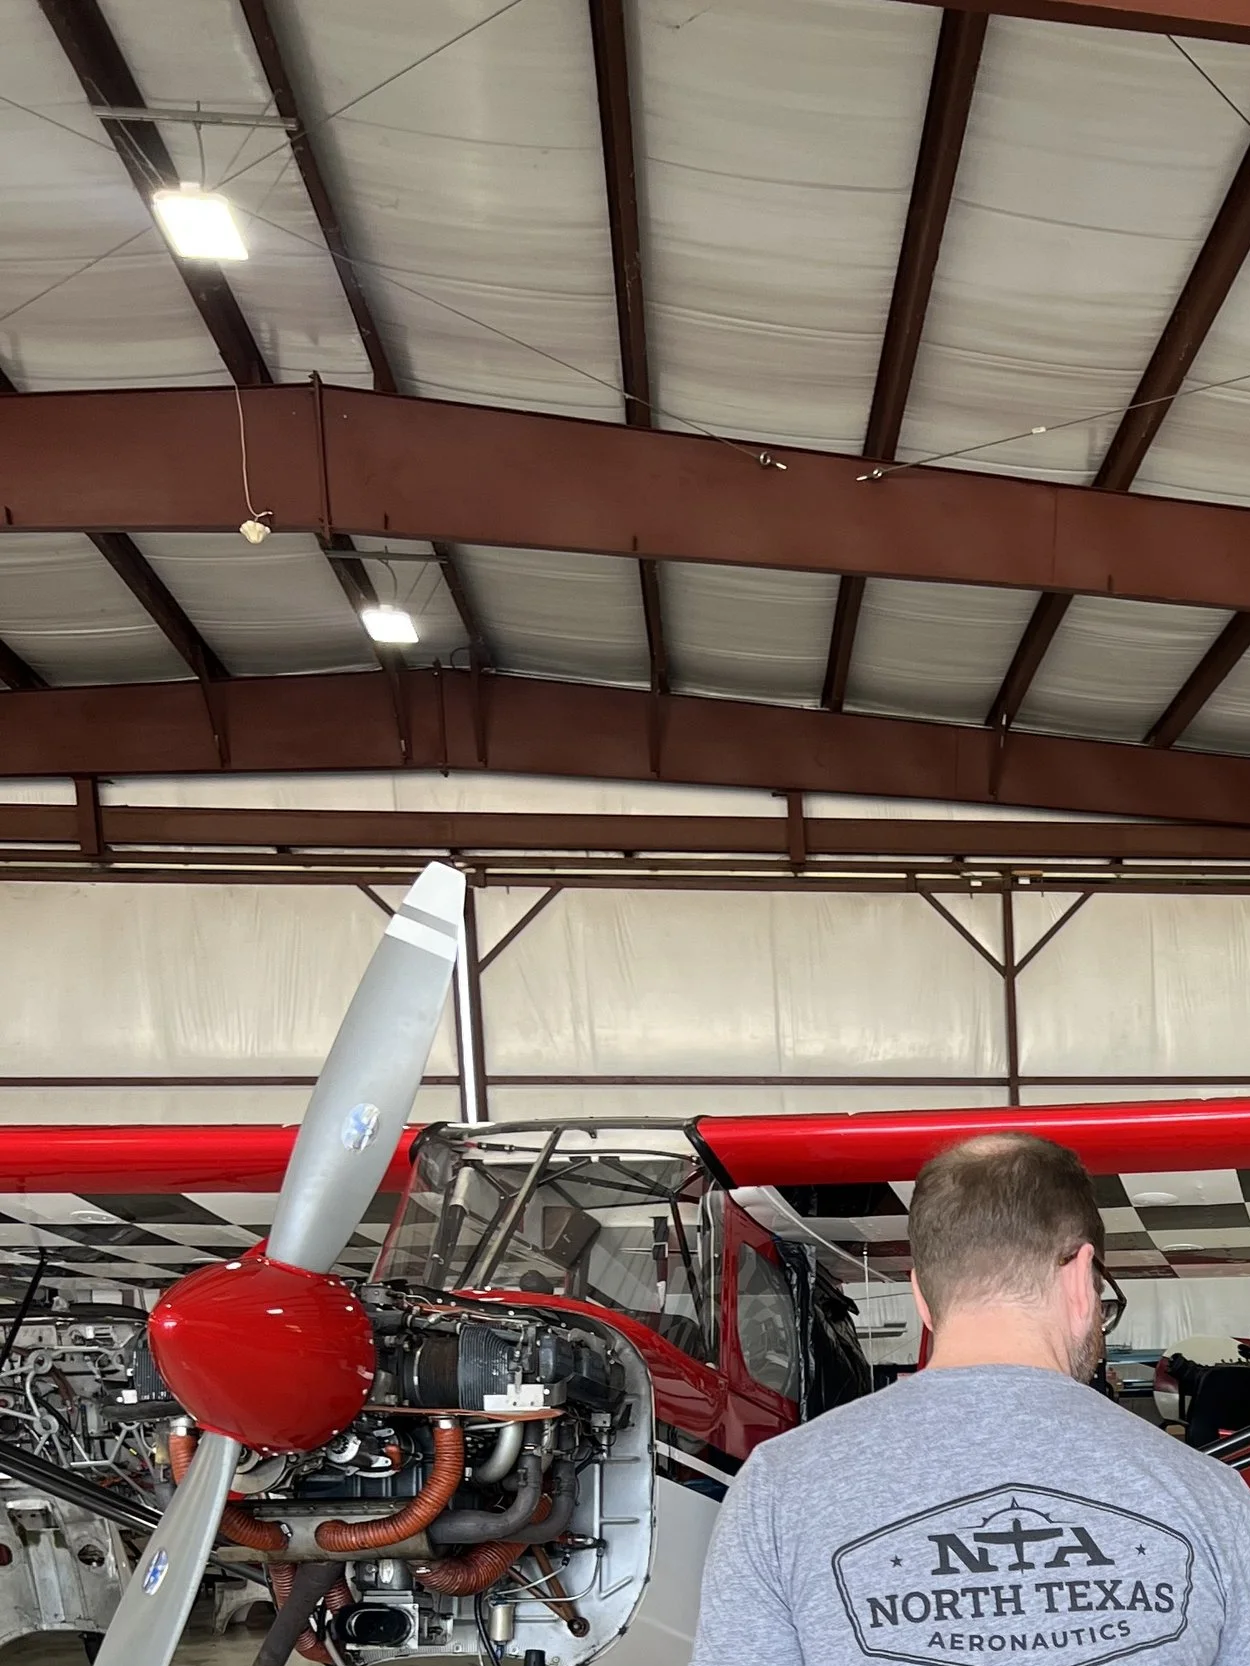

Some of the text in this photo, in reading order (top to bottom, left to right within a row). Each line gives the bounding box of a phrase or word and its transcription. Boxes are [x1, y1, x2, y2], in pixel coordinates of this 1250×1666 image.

[927, 1518, 1115, 1575] NTA
[866, 1579, 1175, 1628] NORTH TEXAS
[927, 1619, 1131, 1651] AERONAUTICS
